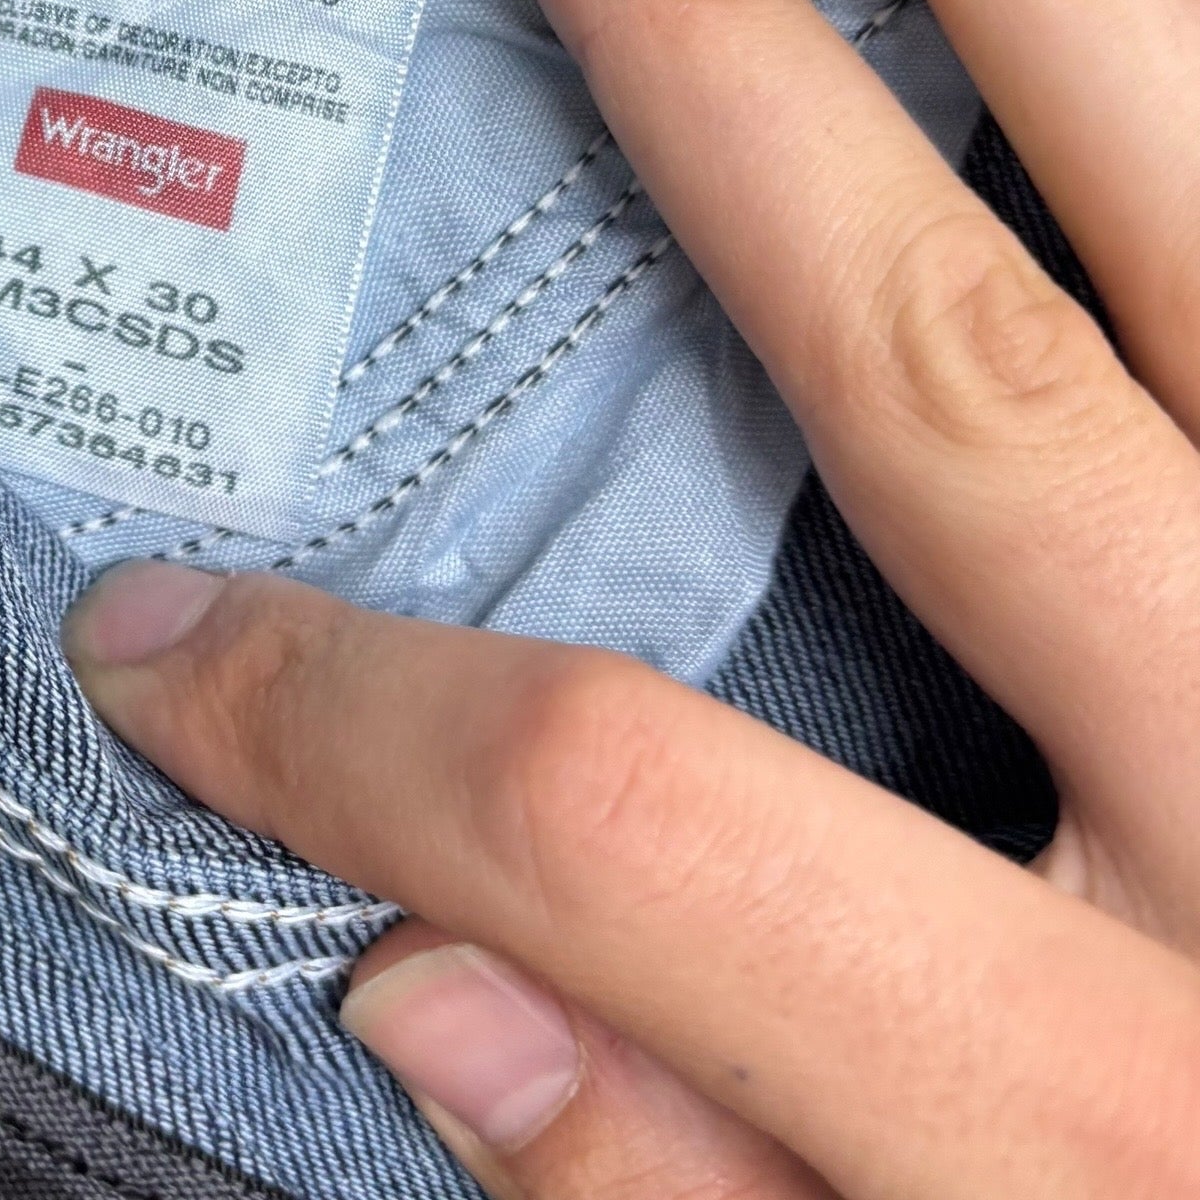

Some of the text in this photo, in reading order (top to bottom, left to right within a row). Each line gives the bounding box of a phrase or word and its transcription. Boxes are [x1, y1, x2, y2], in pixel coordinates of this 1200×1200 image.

[84, 14, 111, 34] OF
[196, 67, 238, 95] NON
[245, 78, 349, 124] COMPRISE
[37, 106, 224, 196] Wrangler
[74, 255, 118, 296] X
[145, 281, 219, 325] 30
